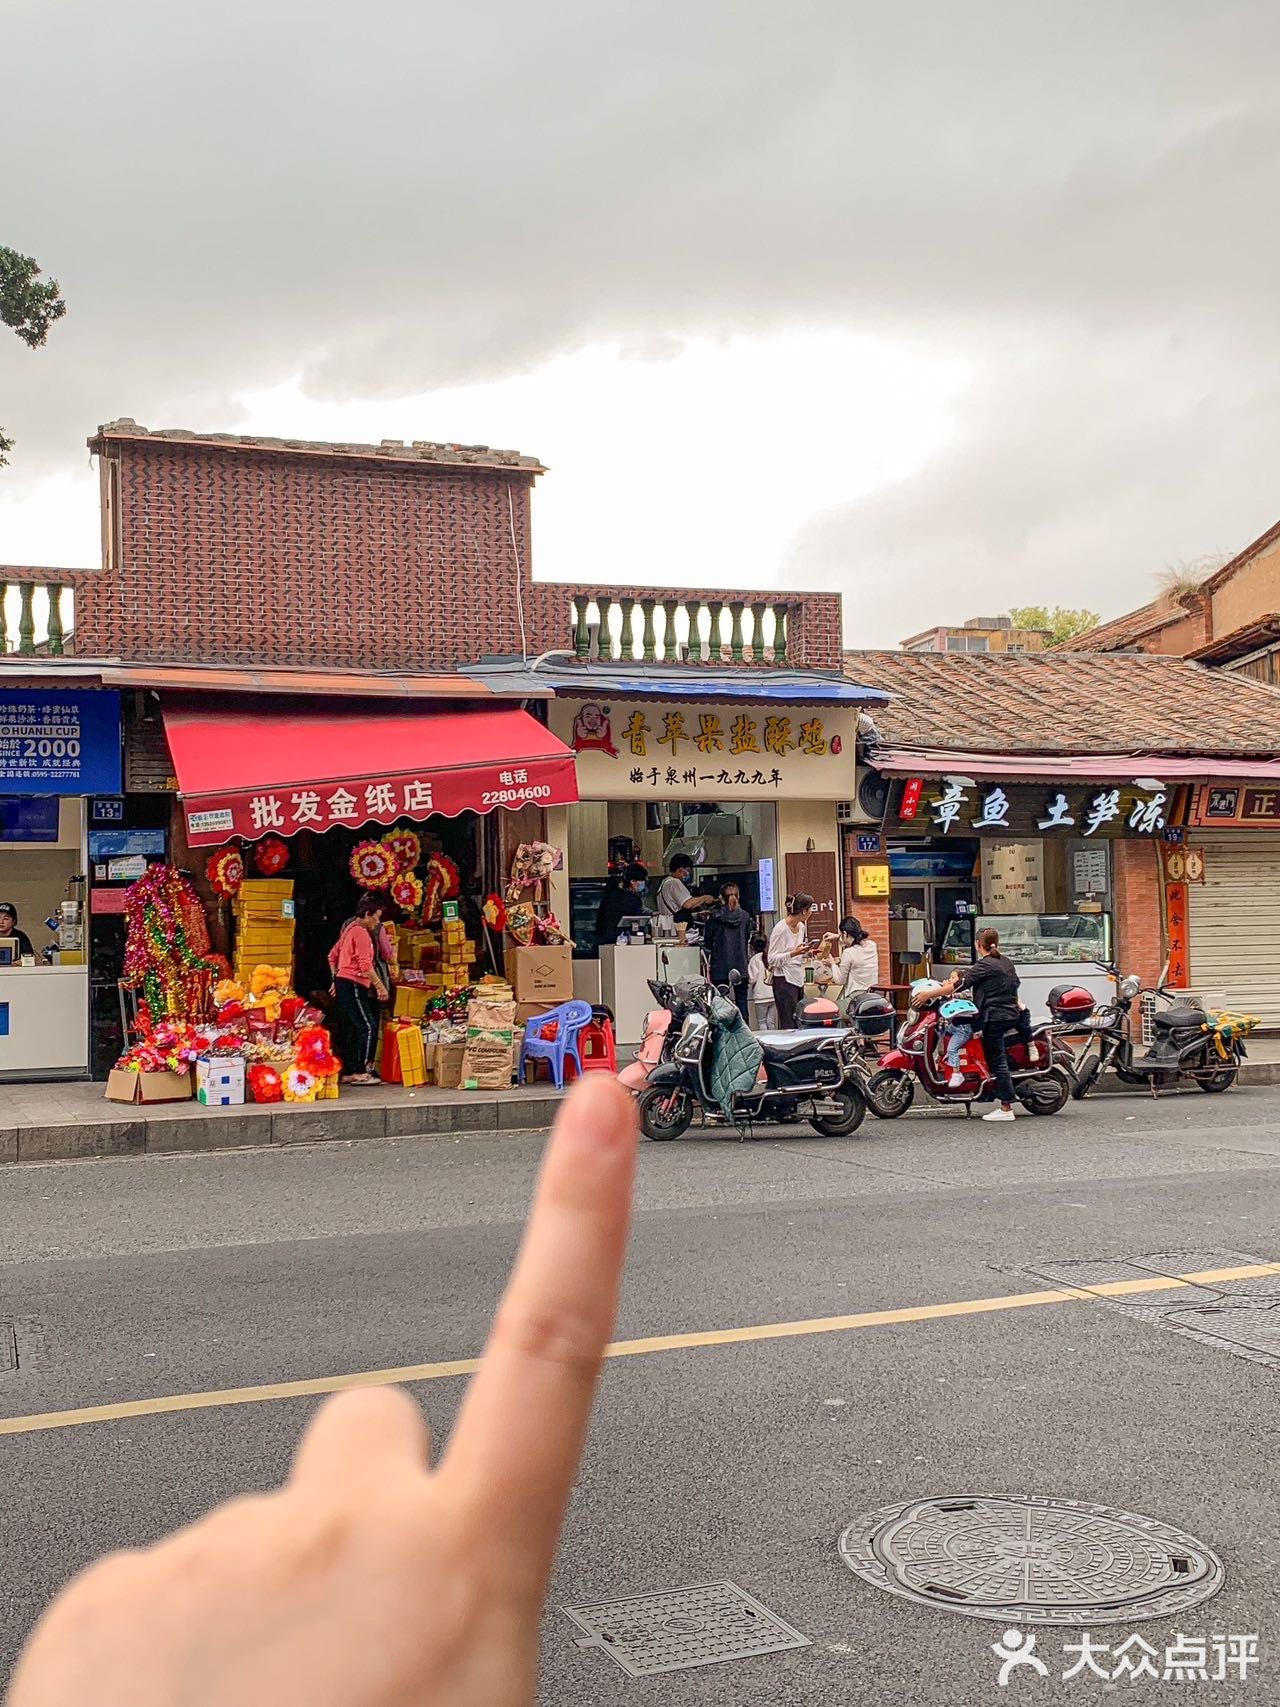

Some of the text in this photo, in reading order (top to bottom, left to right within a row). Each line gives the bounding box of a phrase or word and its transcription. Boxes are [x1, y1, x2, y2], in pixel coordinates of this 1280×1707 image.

[12, 727, 78, 736] HUANLI CUP
[621, 710, 828, 757] 青苹果盐酥鸡
[23, 739, 81, 758] 2000
[499, 768, 528, 786] 电话
[629, 765, 783, 788] 始于泉州一九九九年
[249, 779, 434, 830] 批发金纸店
[481, 784, 551, 805] 22804600
[1249, 793, 1277, 816] 正
